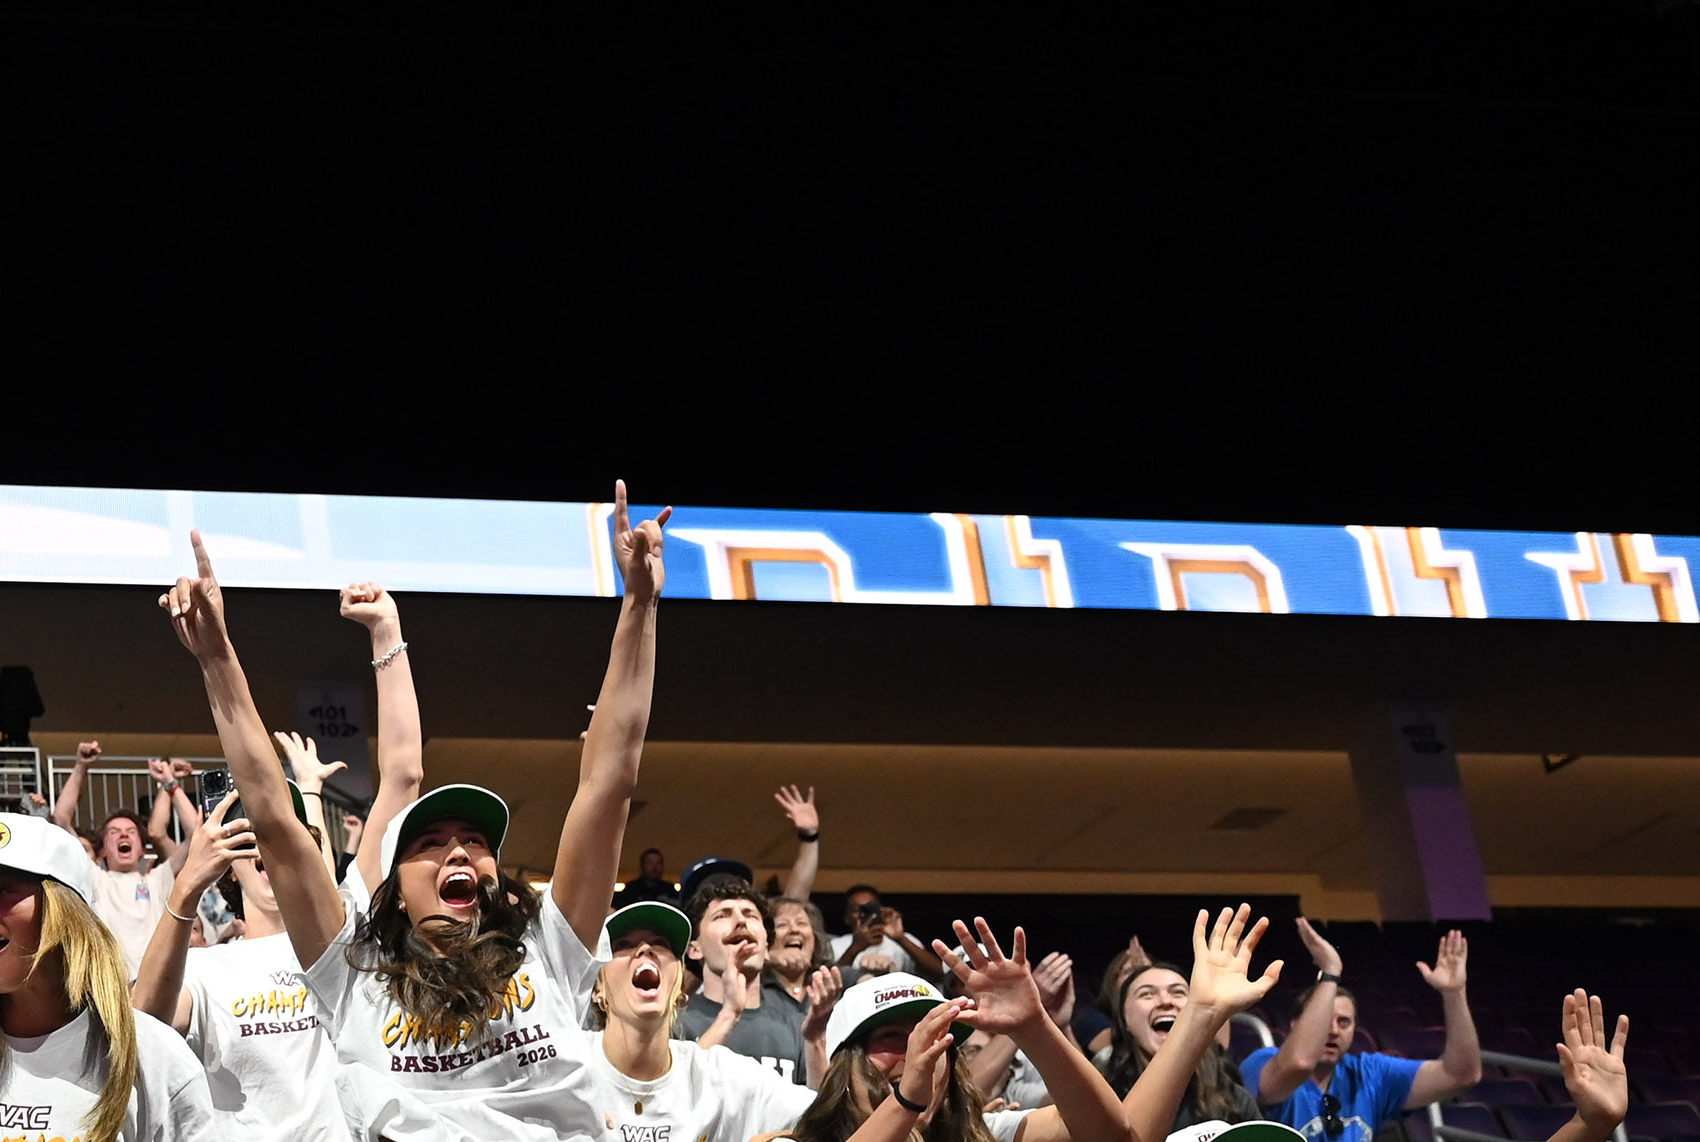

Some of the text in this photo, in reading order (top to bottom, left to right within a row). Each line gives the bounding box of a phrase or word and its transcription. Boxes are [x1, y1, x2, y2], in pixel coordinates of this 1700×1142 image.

[269, 970, 301, 987] WA
[232, 988, 308, 1019] CHAMP
[240, 1015, 320, 1037] BASKET
[391, 1024, 550, 1073] BASKETBALL
[517, 1044, 557, 1067] 2026
